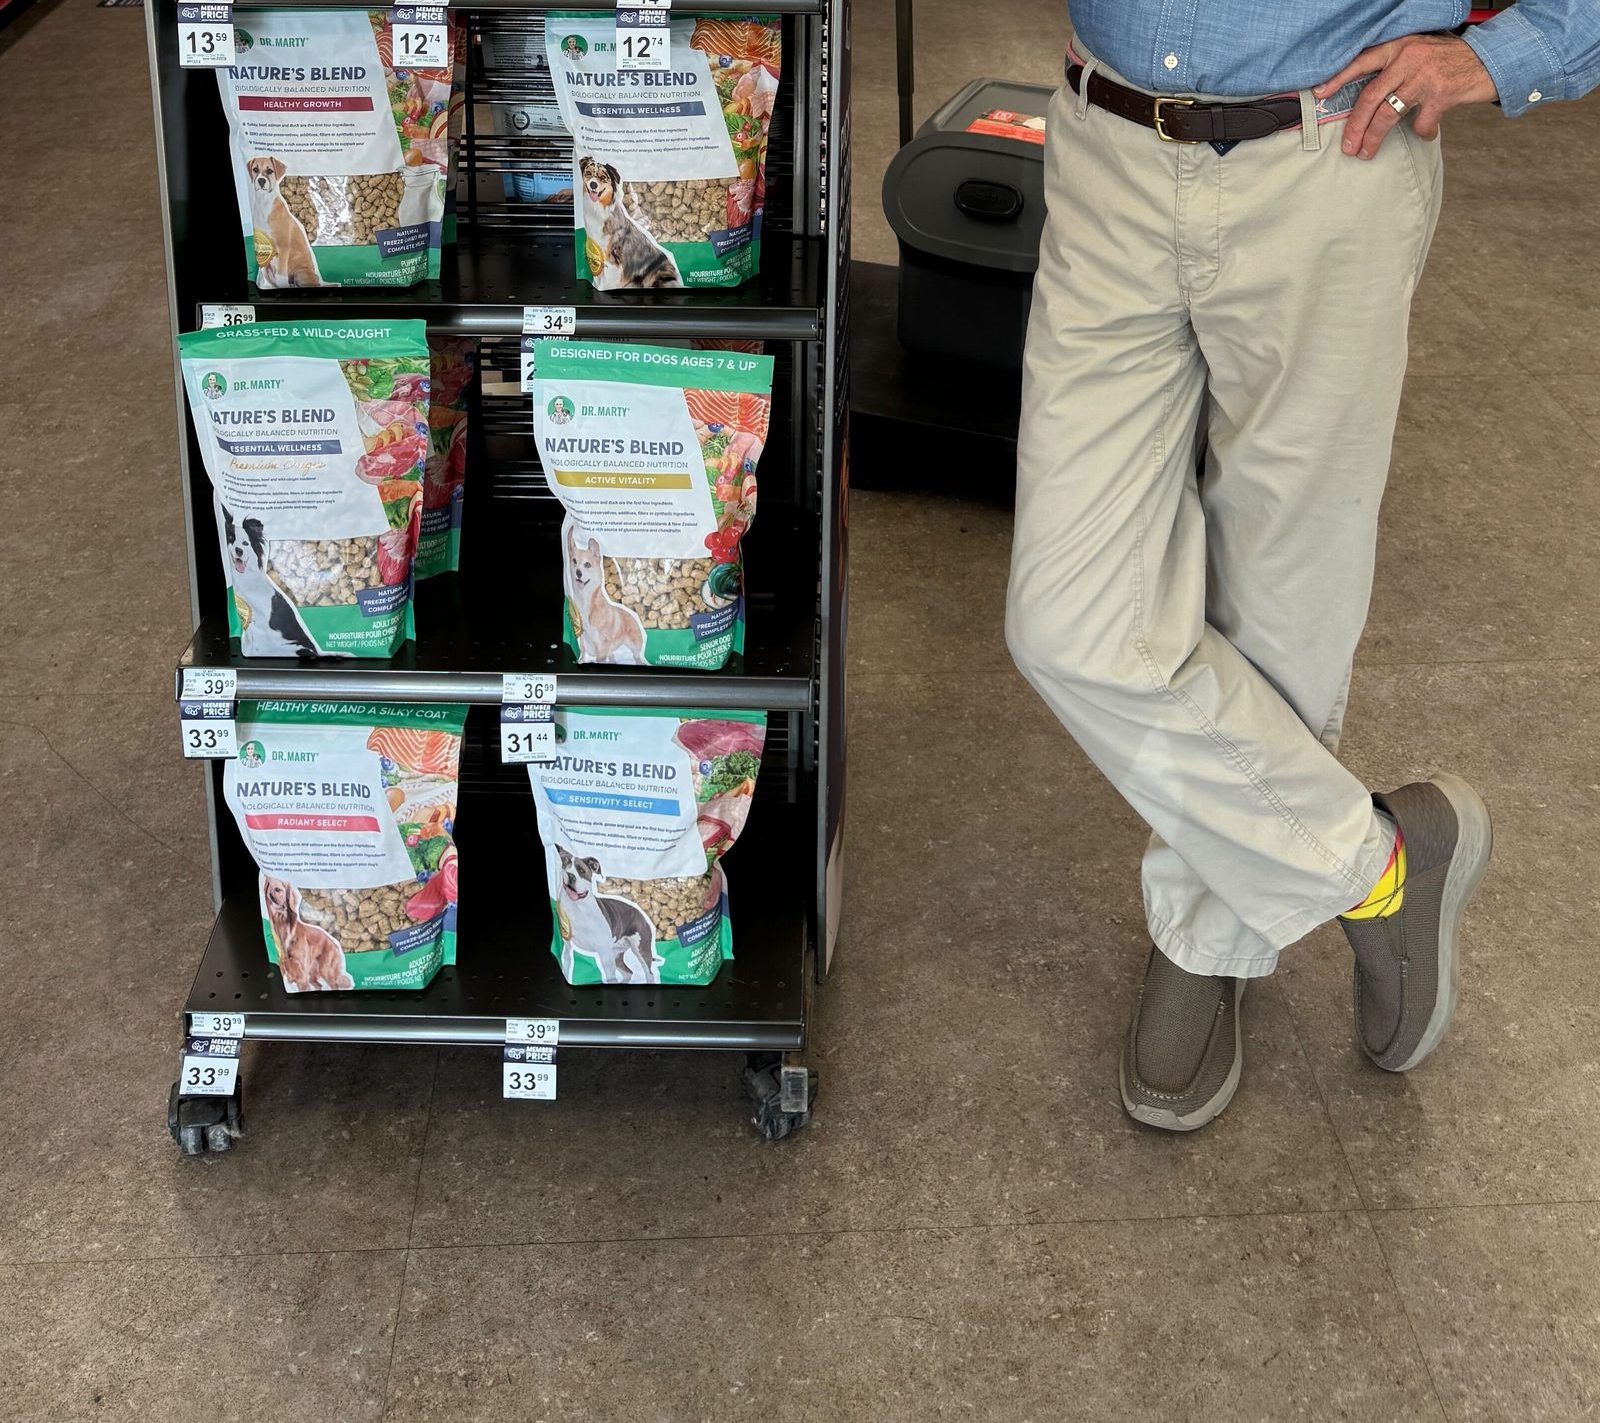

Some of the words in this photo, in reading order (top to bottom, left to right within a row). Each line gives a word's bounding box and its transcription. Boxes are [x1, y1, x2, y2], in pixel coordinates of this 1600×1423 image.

[201, 11, 228, 19] PRICE
[639, 15, 666, 23] PRICE
[311, 67, 366, 81] BLEND
[644, 72, 697, 86] BLEND
[330, 85, 370, 93] NUTRITION
[660, 90, 700, 99] NUTRITION
[638, 106, 681, 114] WELLNESS
[216, 328, 288, 338] GRASS-FED
[292, 328, 300, 337] &
[303, 328, 392, 339] WILD-CAUGHT
[551, 347, 612, 360] DESIGNED
[615, 350, 640, 362] FOR
[644, 352, 678, 365] DOGS
[680, 356, 714, 368] AGES
[717, 358, 725, 368] 7
[727, 359, 735, 370] &
[282, 409, 335, 423] BLEND
[255, 429, 296, 437] BALANCED
[298, 428, 338, 436] NUTRITION
[278, 443, 322, 452] WELLNESS
[545, 437, 625, 454] NATURE'S
[630, 440, 684, 456] BLEND
[603, 460, 645, 468] BALANCED
[647, 461, 688, 470] NUTRITION
[585, 476, 616, 485] ACTIVE
[619, 476, 656, 485] VITALITY
[203, 708, 230, 716] PRICE
[256, 701, 309, 712] HEALTHY
[310, 703, 338, 713] SKIN
[339, 704, 366, 714] AND
[367, 706, 376, 715] A
[379, 707, 413, 717] SILKY
[415, 709, 450, 719] COAT
[622, 762, 676, 780] BLEND
[237, 782, 317, 797] NATURE'S
[322, 782, 371, 798] BLEND
[595, 780, 638, 790] BALANCED
[638, 784, 678, 794] NUTRITION
[569, 794, 620, 806] SENSITIVITY
[623, 799, 654, 809] SELECT
[296, 802, 335, 810] BALANCED
[338, 803, 375, 813] NUTRITION
[278, 818, 315, 826] RADIANT
[317, 819, 348, 827] SELECT
[209, 1045, 236, 1054] PRICE
[526, 1052, 553, 1060] PRICE
